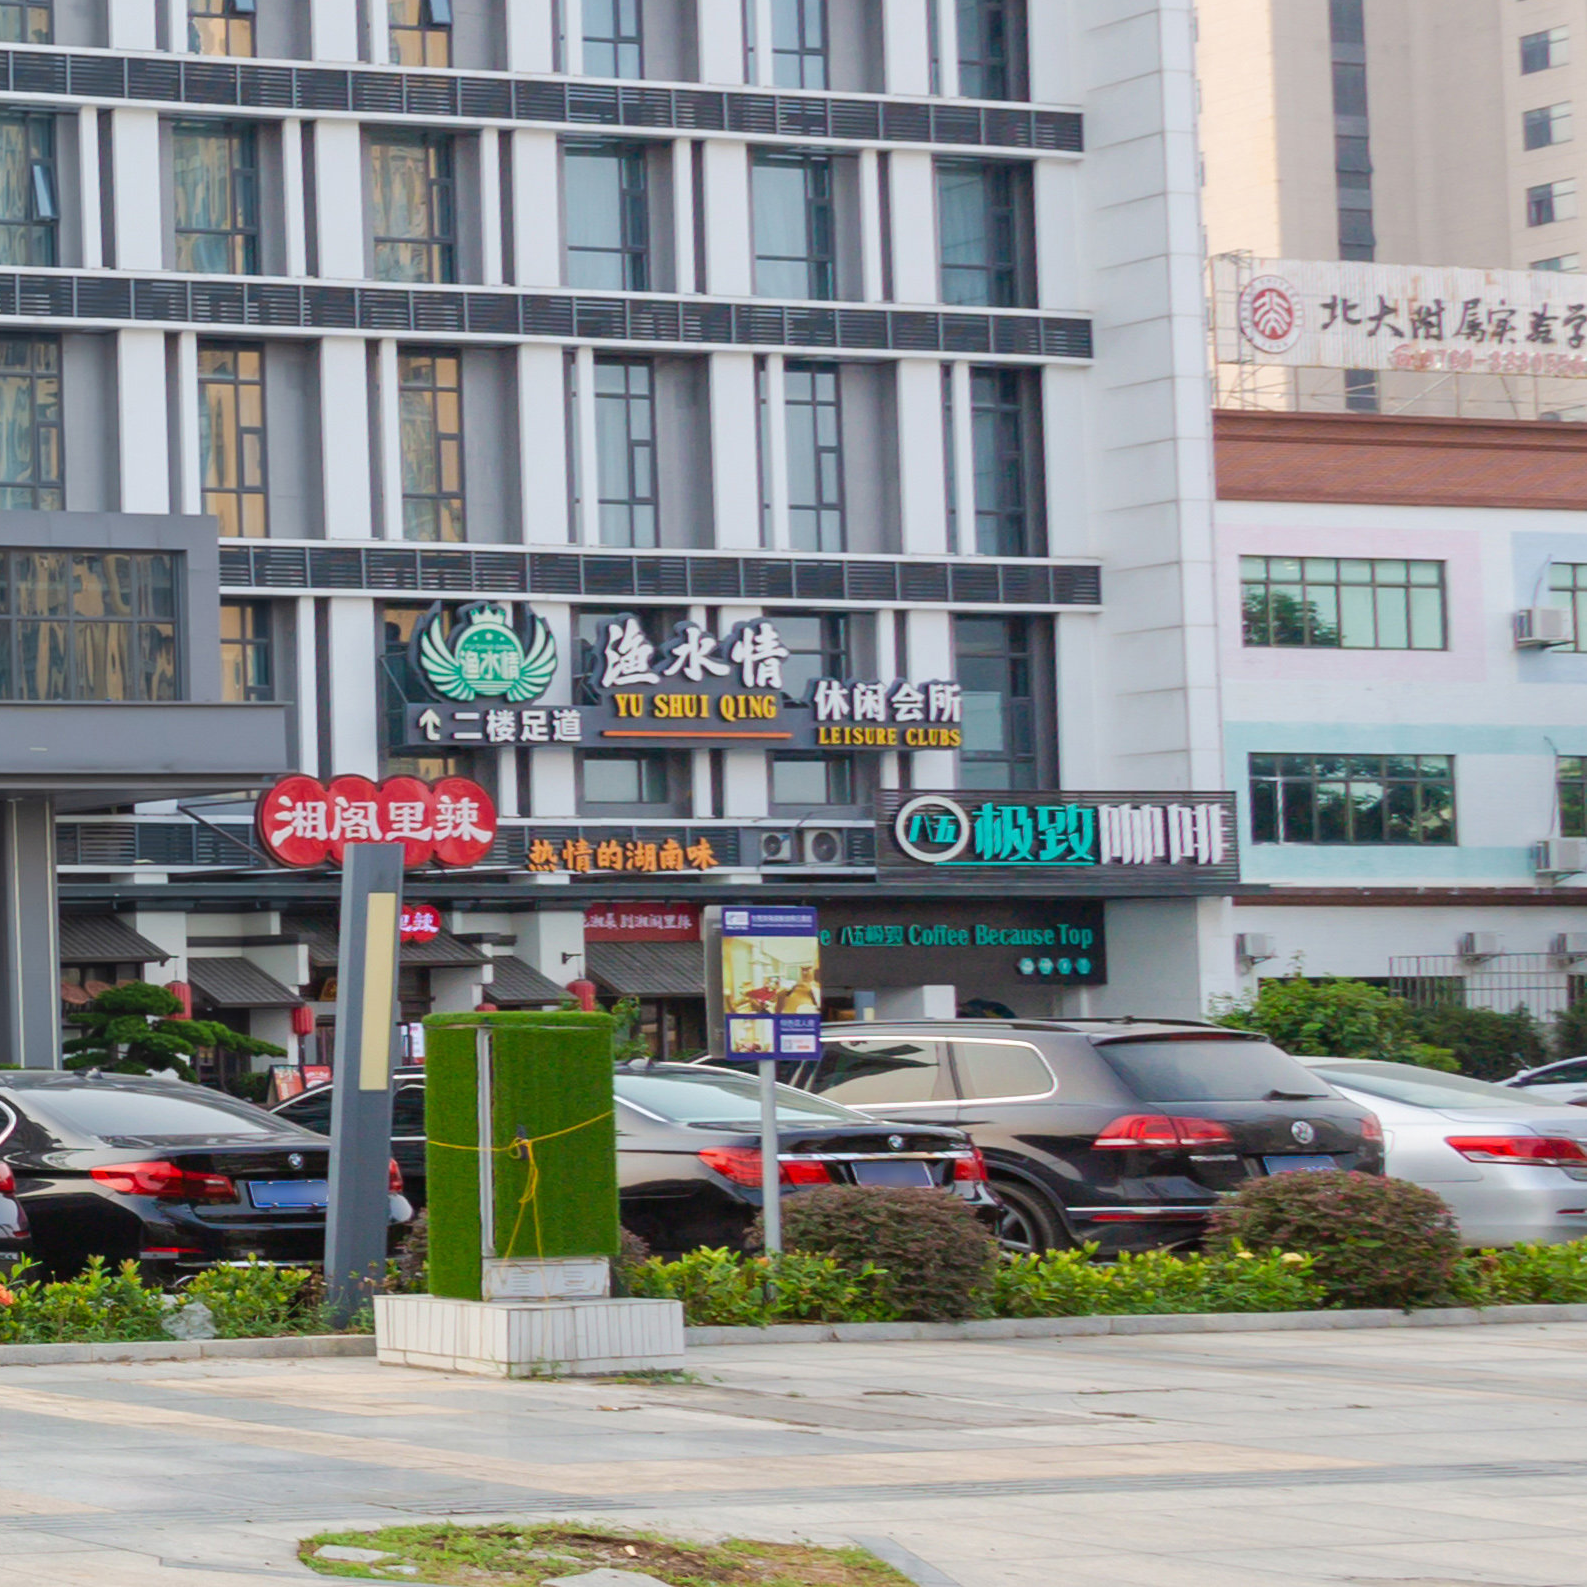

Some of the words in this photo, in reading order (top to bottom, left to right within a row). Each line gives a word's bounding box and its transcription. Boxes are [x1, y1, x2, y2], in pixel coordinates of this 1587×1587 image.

[602, 618, 791, 689] 渔水情
[614, 693, 644, 718] YU
[653, 693, 710, 719] SHUI
[719, 694, 777, 721] QING
[813, 680, 963, 723] 休闲会所
[452, 708, 583, 743] 二楼足道
[817, 726, 898, 745] LEISURE
[905, 727, 961, 747] CLUBS
[271, 795, 494, 846] 湘阁里辣
[972, 802, 1229, 865] 极致咖啡
[527, 837, 719, 873] 热情的湖南味
[908, 924, 970, 946] Coffee
[975, 924, 1055, 946] Because
[1056, 923, 1093, 949] Top
